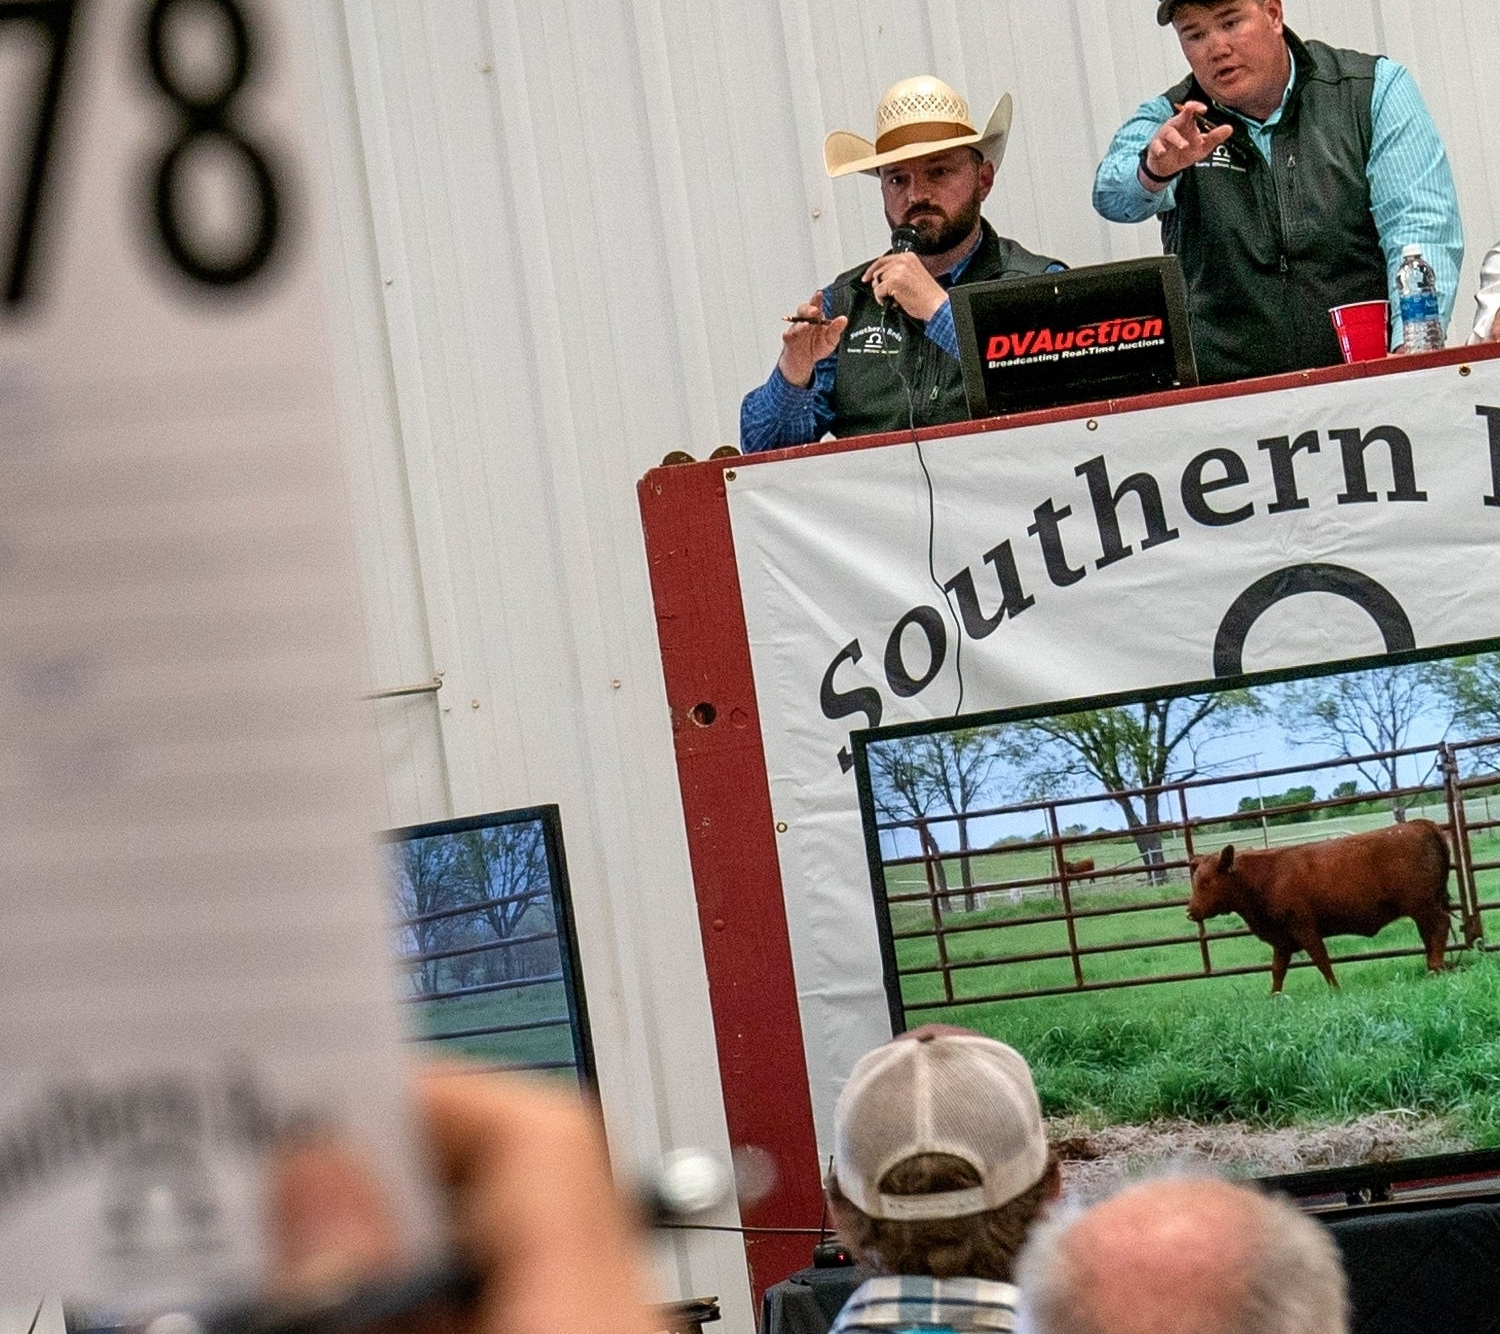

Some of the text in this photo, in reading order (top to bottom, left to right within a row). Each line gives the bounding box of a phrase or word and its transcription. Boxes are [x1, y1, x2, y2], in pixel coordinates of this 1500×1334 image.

[986, 318, 1163, 360] DVAuction
[988, 338, 1165, 369] Broadcasting Real-Time Auctions
[820, 421, 1427, 774] Southern
